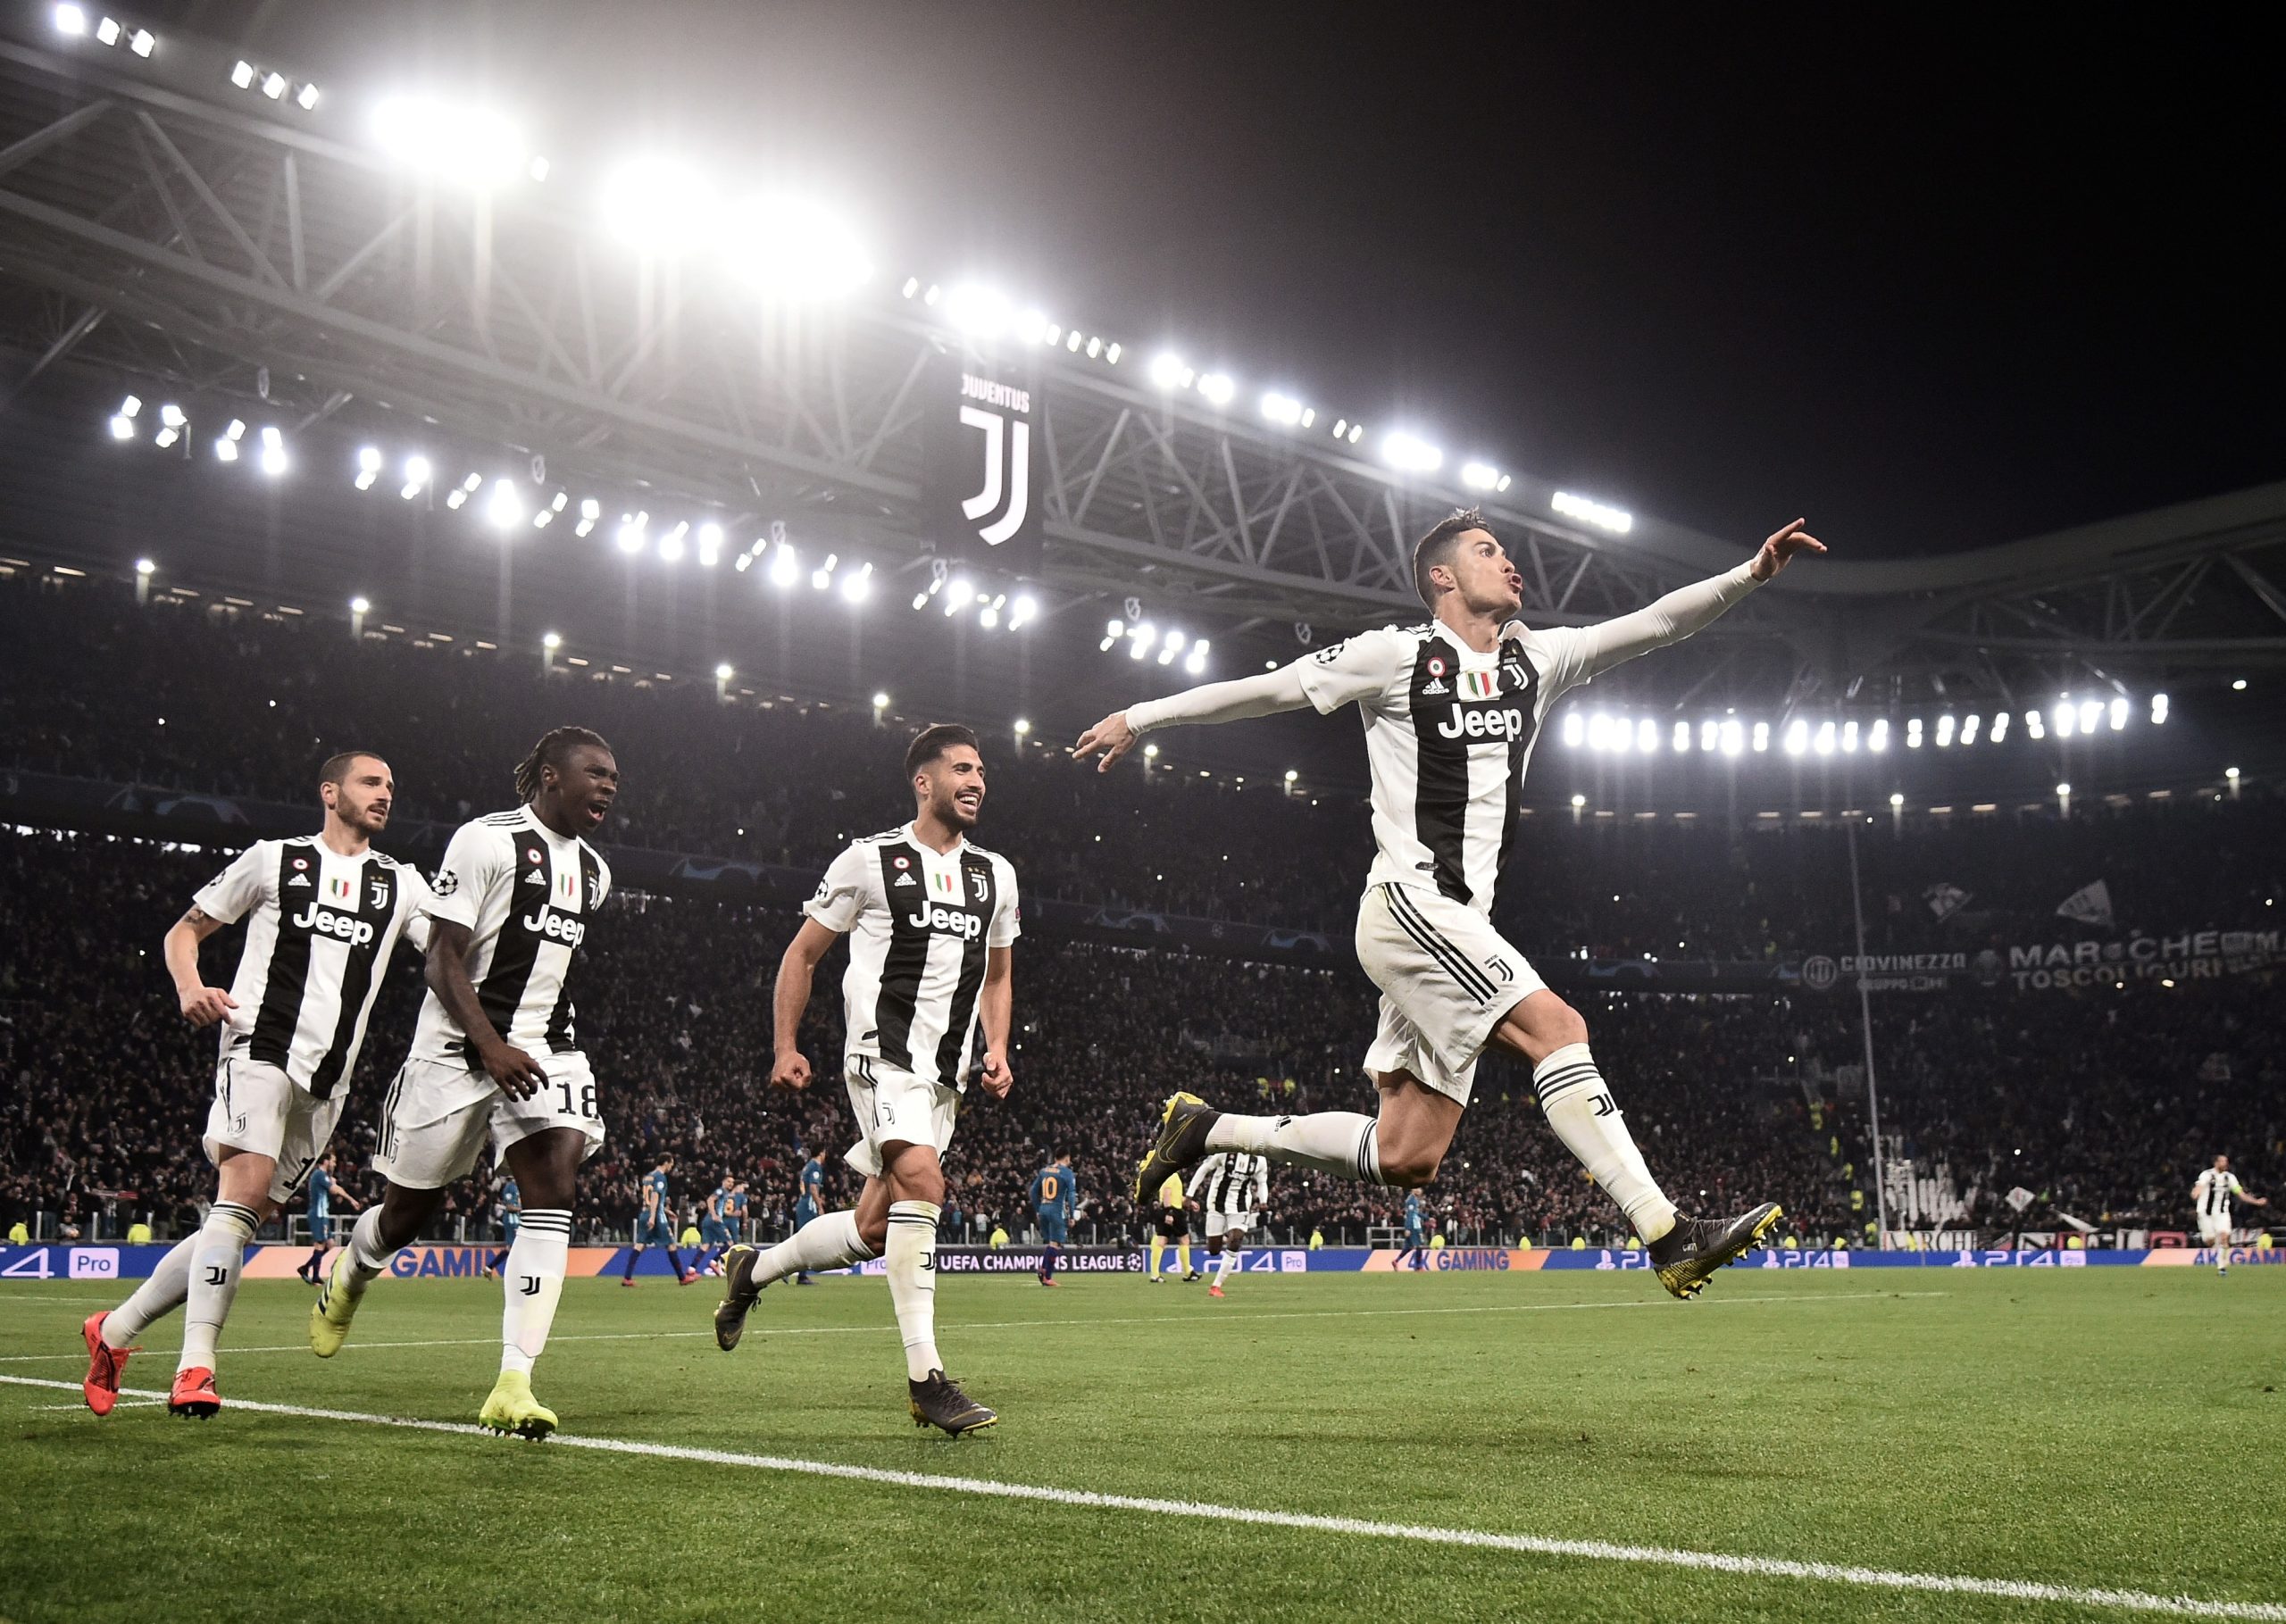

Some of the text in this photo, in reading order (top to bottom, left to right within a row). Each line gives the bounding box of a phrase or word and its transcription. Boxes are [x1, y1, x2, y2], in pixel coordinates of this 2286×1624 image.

[961, 373, 1030, 413] JUVENTUS
[1437, 703, 1523, 742] Jeep
[293, 901, 374, 946] Jeep
[523, 904, 586, 949] Jeep
[909, 900, 981, 940] Jeep
[556, 1081, 600, 1120] 18
[0, 1247, 111, 1279] 4 Pro
[390, 1248, 506, 1278] GAMIN
[940, 1255, 980, 1270] UEFA
[1072, 1255, 1124, 1270] LEAGUE
[1286, 1257, 1302, 1268] Pro
[1437, 1250, 1509, 1270] GAMING
[1784, 1251, 1831, 1269] PS4
[1984, 1250, 2056, 1267] PS4
[2229, 1248, 2286, 1265] GAM
